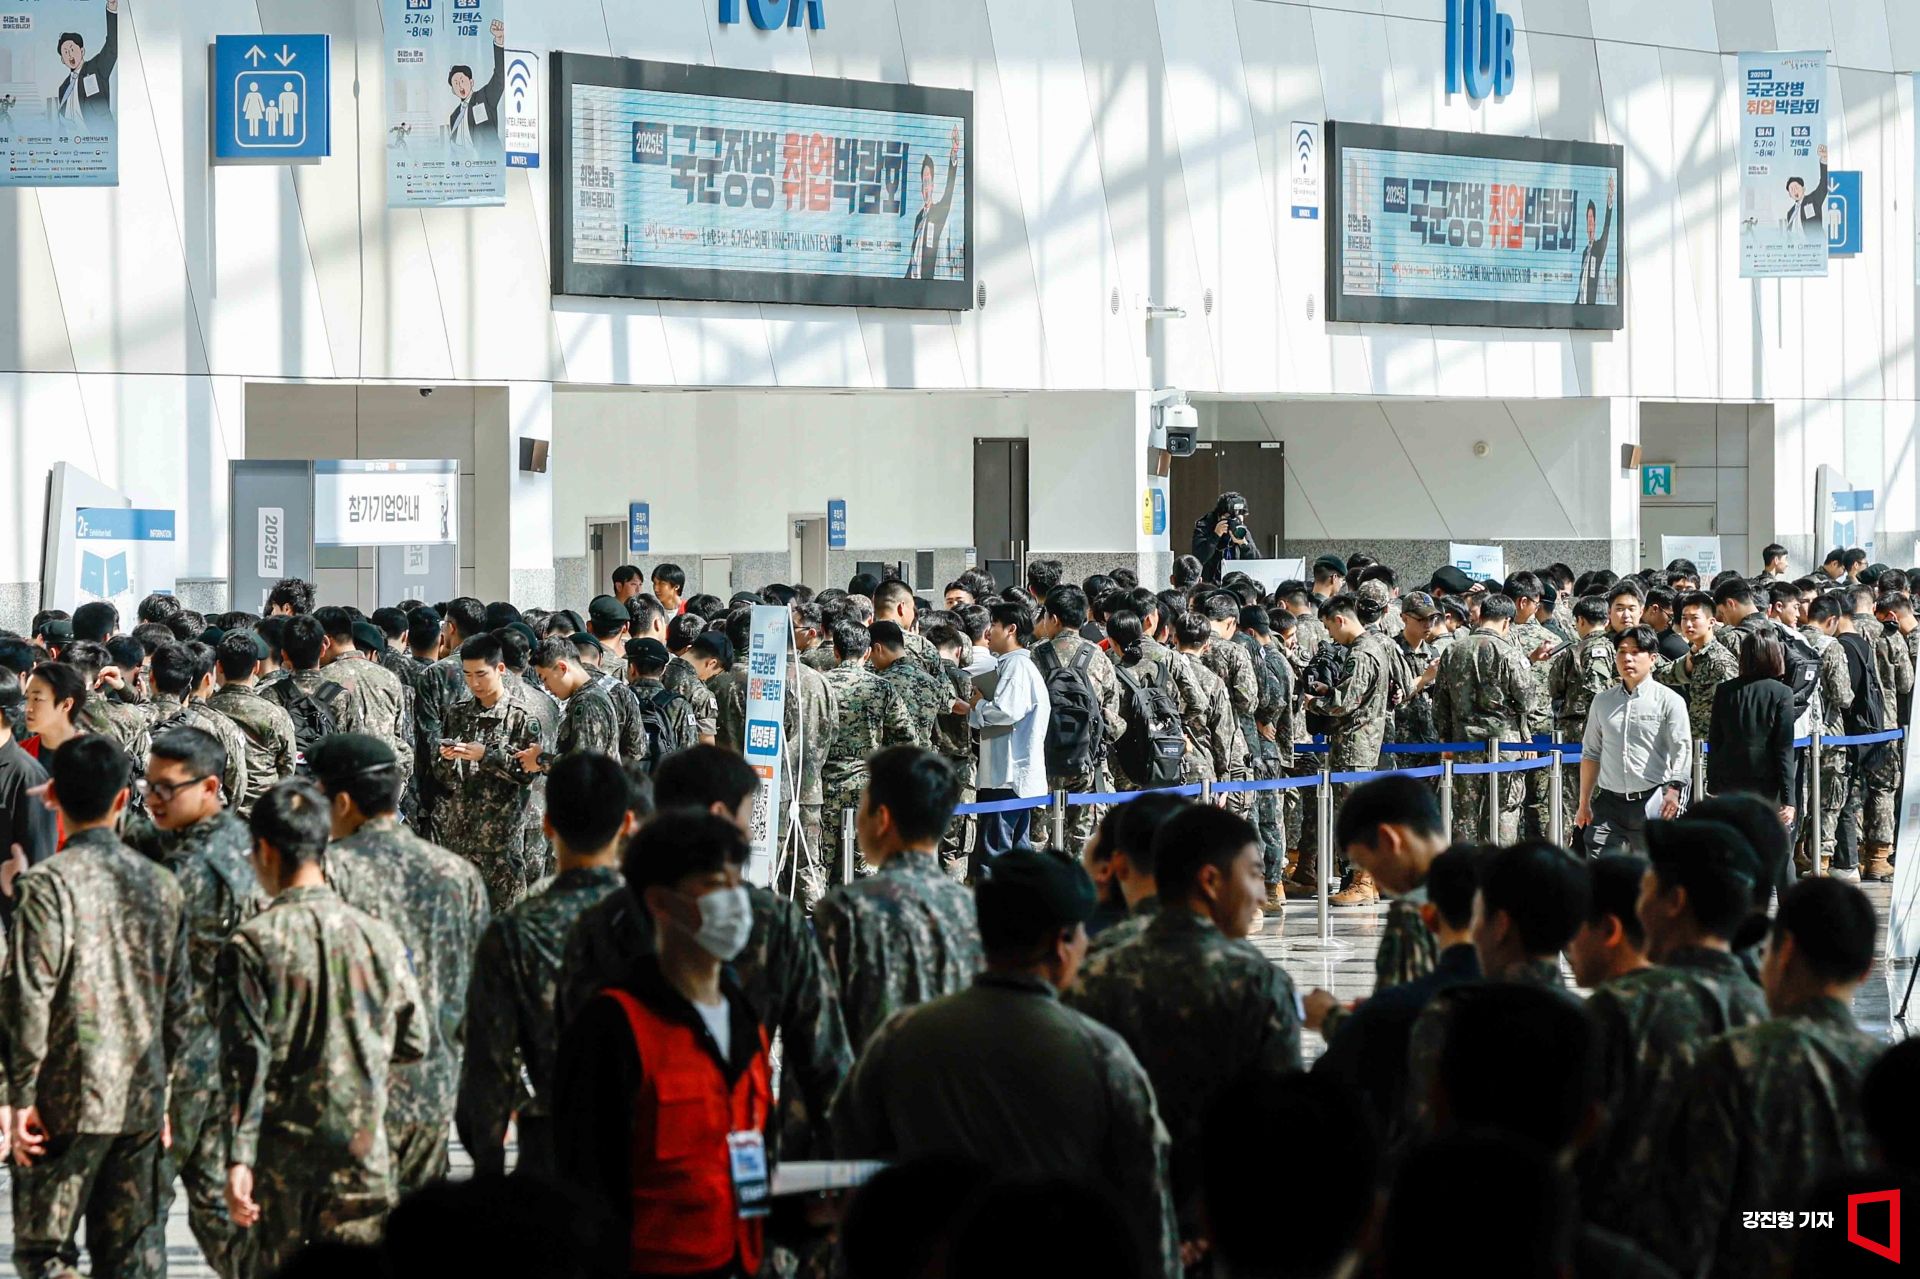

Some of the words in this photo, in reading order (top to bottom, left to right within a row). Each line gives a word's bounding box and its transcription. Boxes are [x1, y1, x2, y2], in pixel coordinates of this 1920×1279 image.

[404, 13, 434, 24] 5.7(수)
[452, 12, 482, 23] 킨텍스
[406, 26, 433, 37] ~8(목)
[457, 25, 479, 36] 10홀
[1747, 82, 1805, 97] 국군장병
[1747, 99, 1820, 115] 취업박람회
[1754, 140, 1776, 148] 5.7(수)
[1790, 139, 1812, 147] 킨텍스
[635, 132, 664, 155] 2025년
[670, 124, 778, 209] 국군장병
[782, 132, 910, 218] 취업박람회
[1386, 185, 1406, 205] 2025년
[1410, 178, 1485, 247] 국군장병
[1489, 183, 1578, 253] 취업박람회
[801, 232, 829, 253] KINTEX
[349, 494, 420, 523] 참가기업안내
[78, 515, 89, 538] 2F
[264, 515, 278, 571] 2025년
[752, 652, 777, 676] 국군장병
[749, 677, 782, 702] 취업박람회
[750, 724, 777, 749] 현장등록
